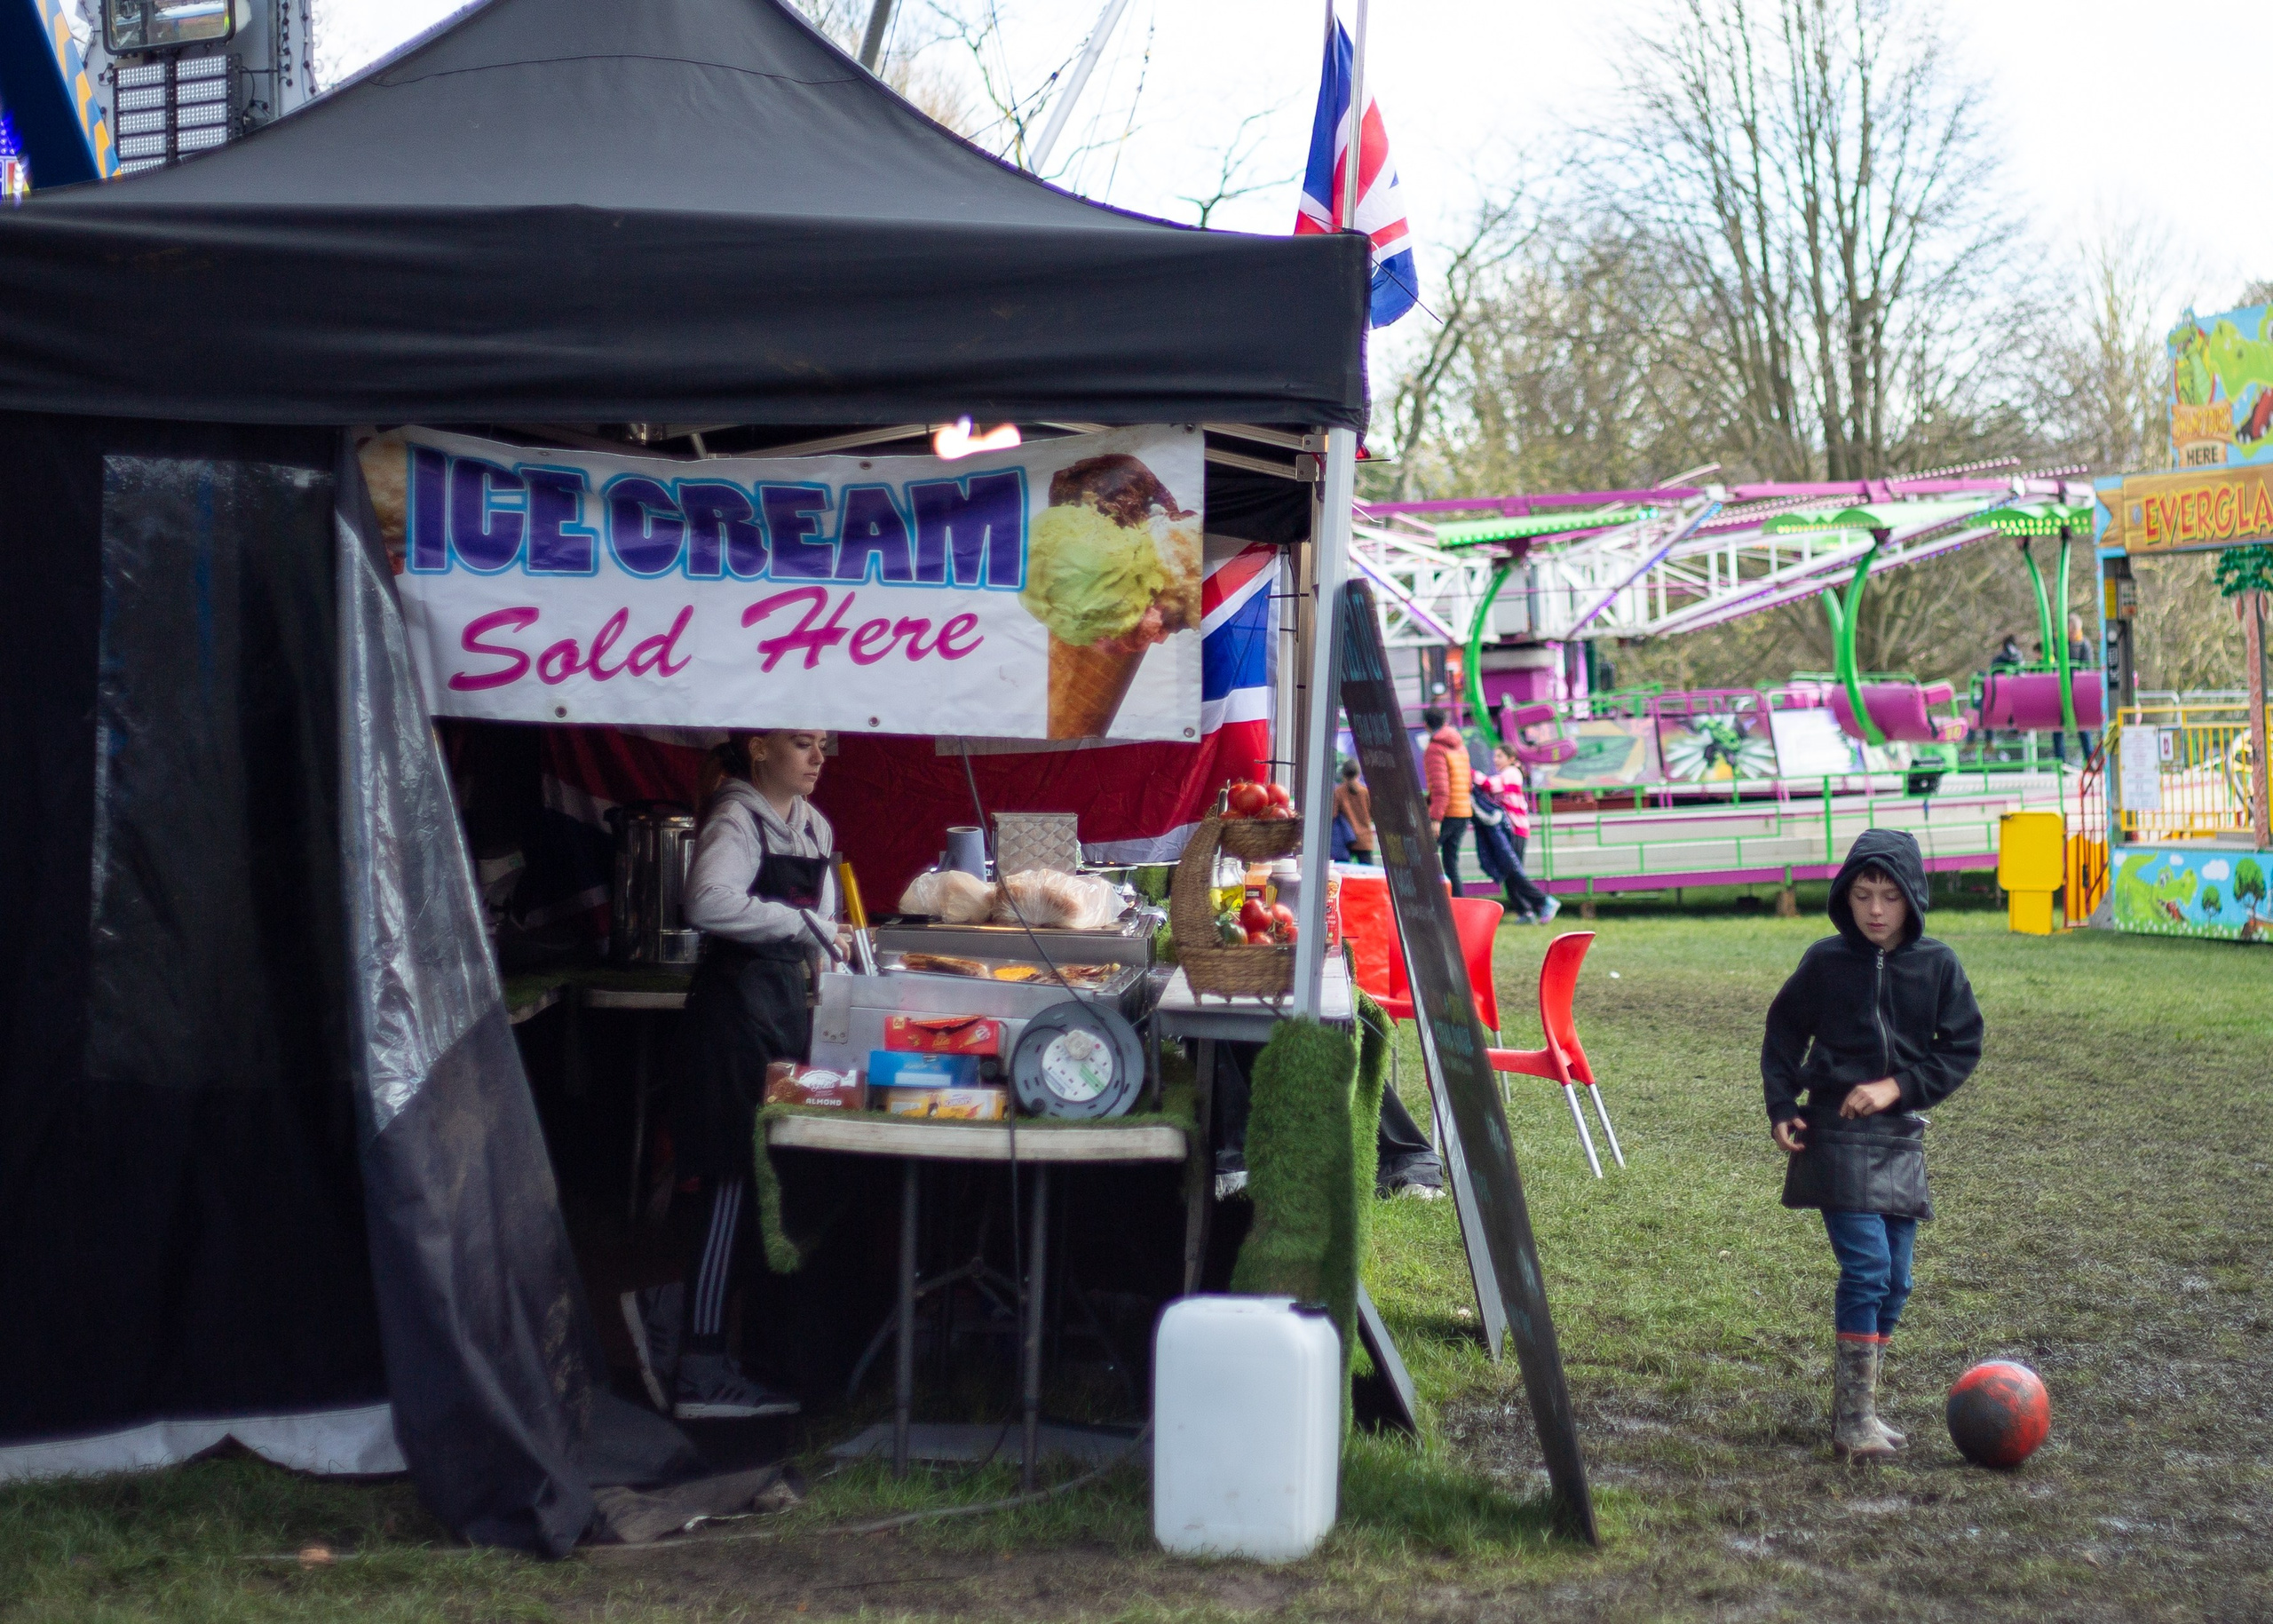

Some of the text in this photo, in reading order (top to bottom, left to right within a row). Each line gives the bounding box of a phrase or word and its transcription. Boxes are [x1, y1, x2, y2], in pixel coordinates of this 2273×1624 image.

[2186, 444, 2220, 466] HERE
[406, 443, 1029, 592] ICE CREAM
[2142, 476, 2273, 545] EVERGLA
[447, 585, 985, 692] Sold Here
[805, 1097, 843, 1106] ALMOND
